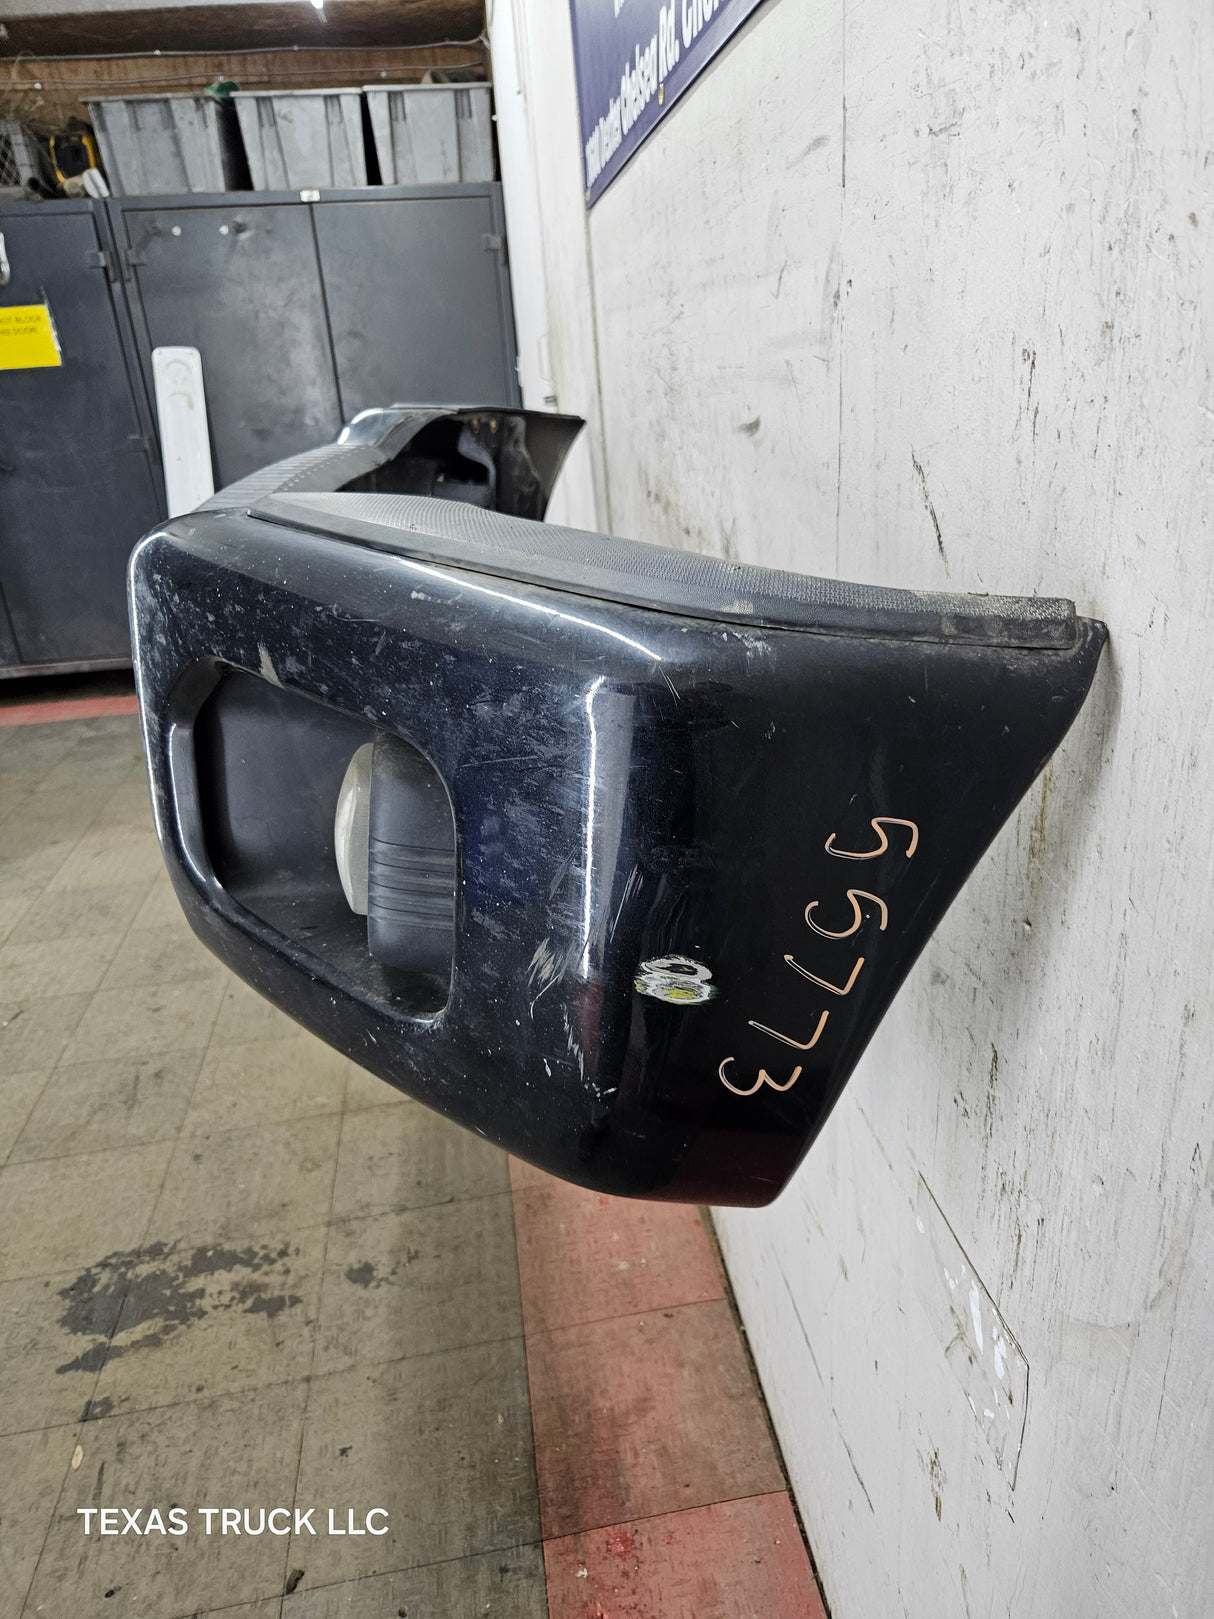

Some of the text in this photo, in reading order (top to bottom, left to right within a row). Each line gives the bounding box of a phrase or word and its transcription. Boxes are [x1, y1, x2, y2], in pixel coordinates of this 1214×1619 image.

[620, 33, 658, 135] Chelsea
[659, 0, 680, 83] Rd.
[719, 817, 919, 1096] 55773
